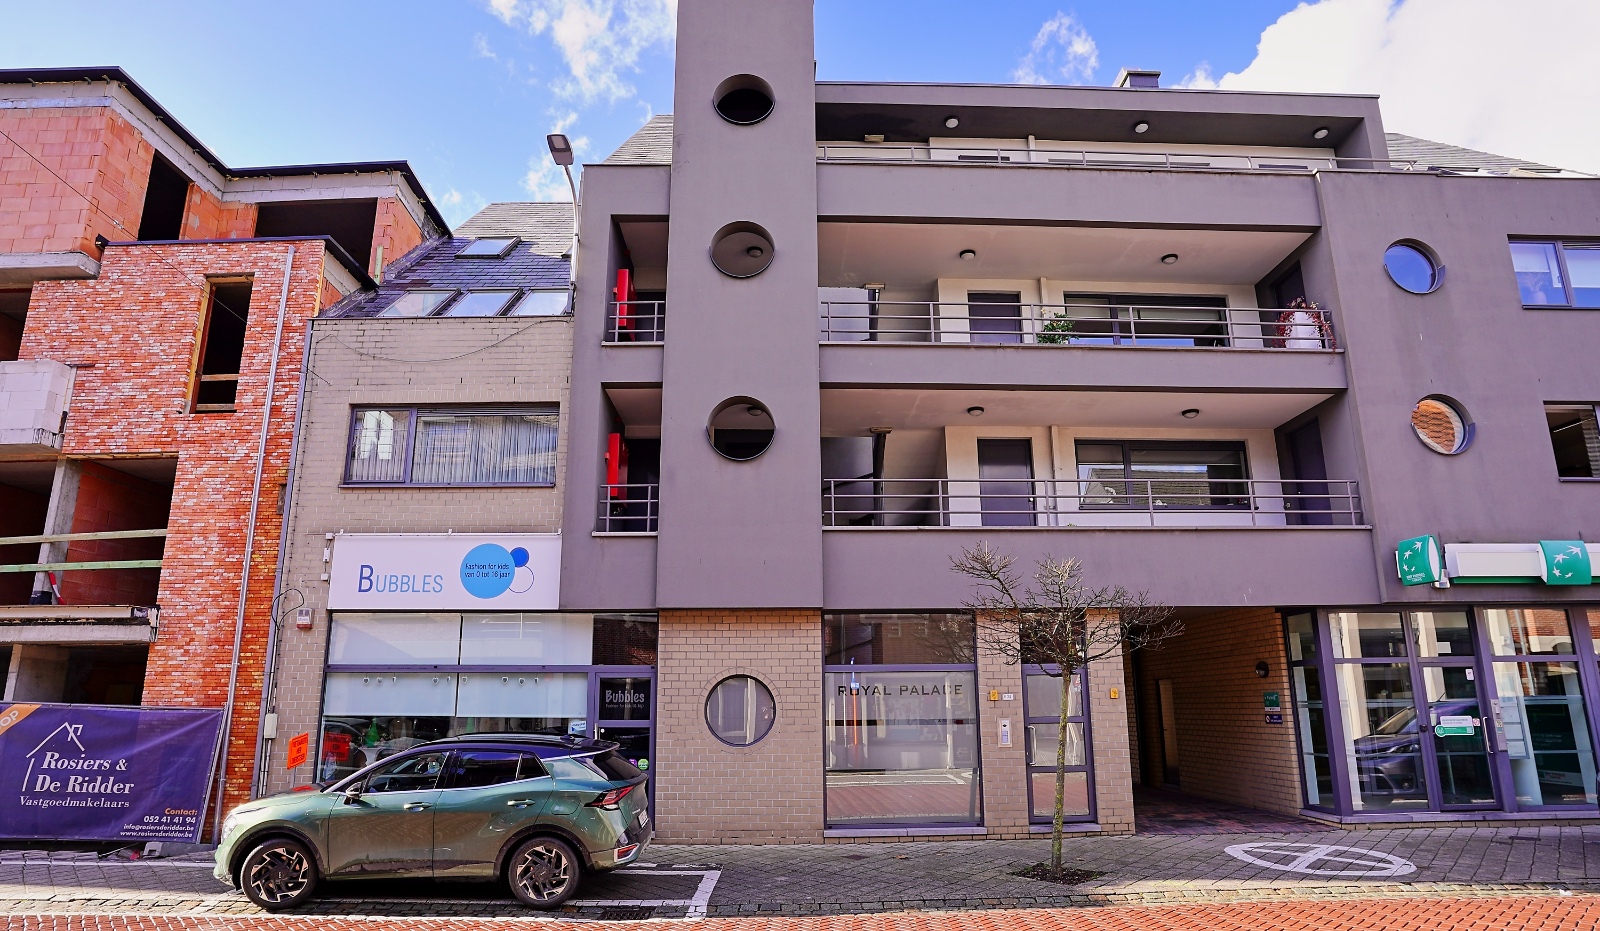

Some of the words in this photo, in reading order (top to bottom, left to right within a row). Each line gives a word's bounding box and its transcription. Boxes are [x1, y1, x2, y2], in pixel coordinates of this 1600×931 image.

[499, 571, 510, 579] jaar
[606, 690, 644, 702] Bubbles
[838, 685, 892, 696] ROYAL
[900, 684, 963, 695] PALACE
[0, 710, 19, 730] OP
[41, 751, 111, 771] Rosiers
[116, 758, 128, 771] &
[34, 774, 60, 793] De
[66, 775, 135, 794] Ridder
[20, 796, 130, 809] Vastgoedmakelaars
[165, 807, 198, 815] Contact:
